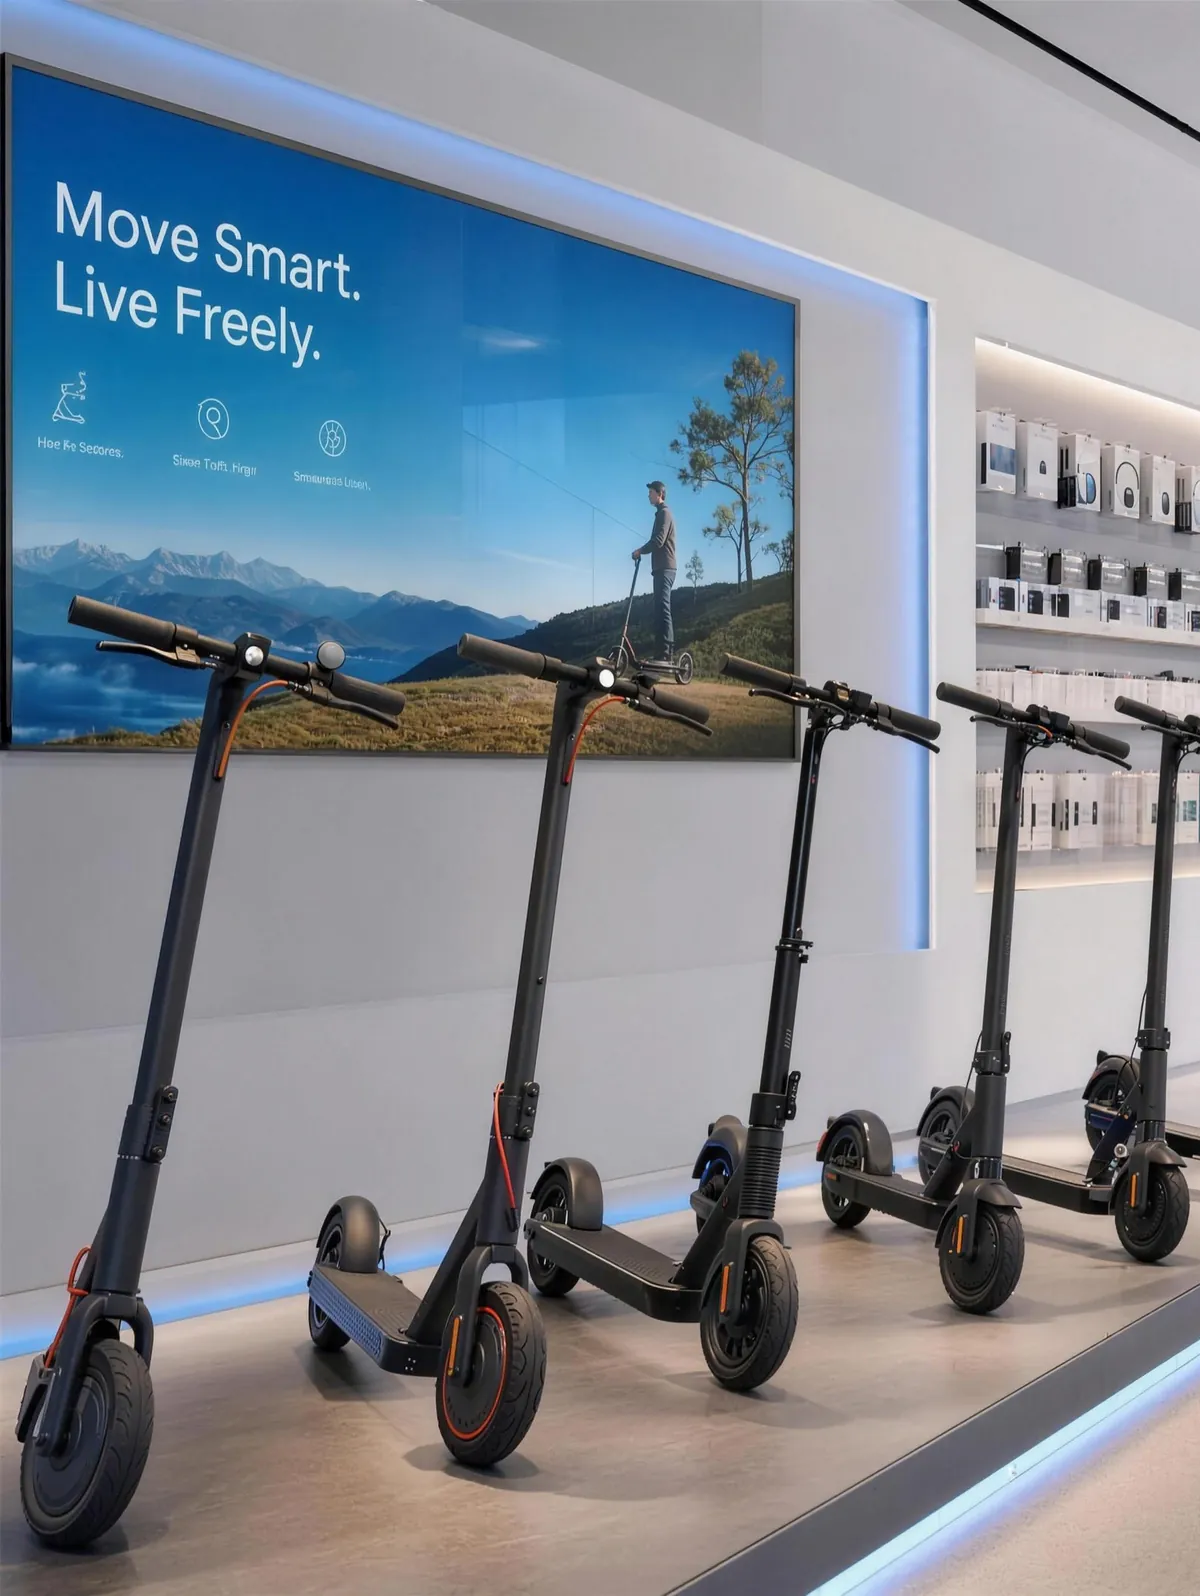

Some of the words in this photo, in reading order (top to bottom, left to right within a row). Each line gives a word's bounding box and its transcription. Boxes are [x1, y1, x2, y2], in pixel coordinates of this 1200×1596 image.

[56, 181, 199, 263] Move
[214, 222, 361, 301] Smart.
[56, 260, 158, 329] Live
[176, 285, 321, 369] Freely.
